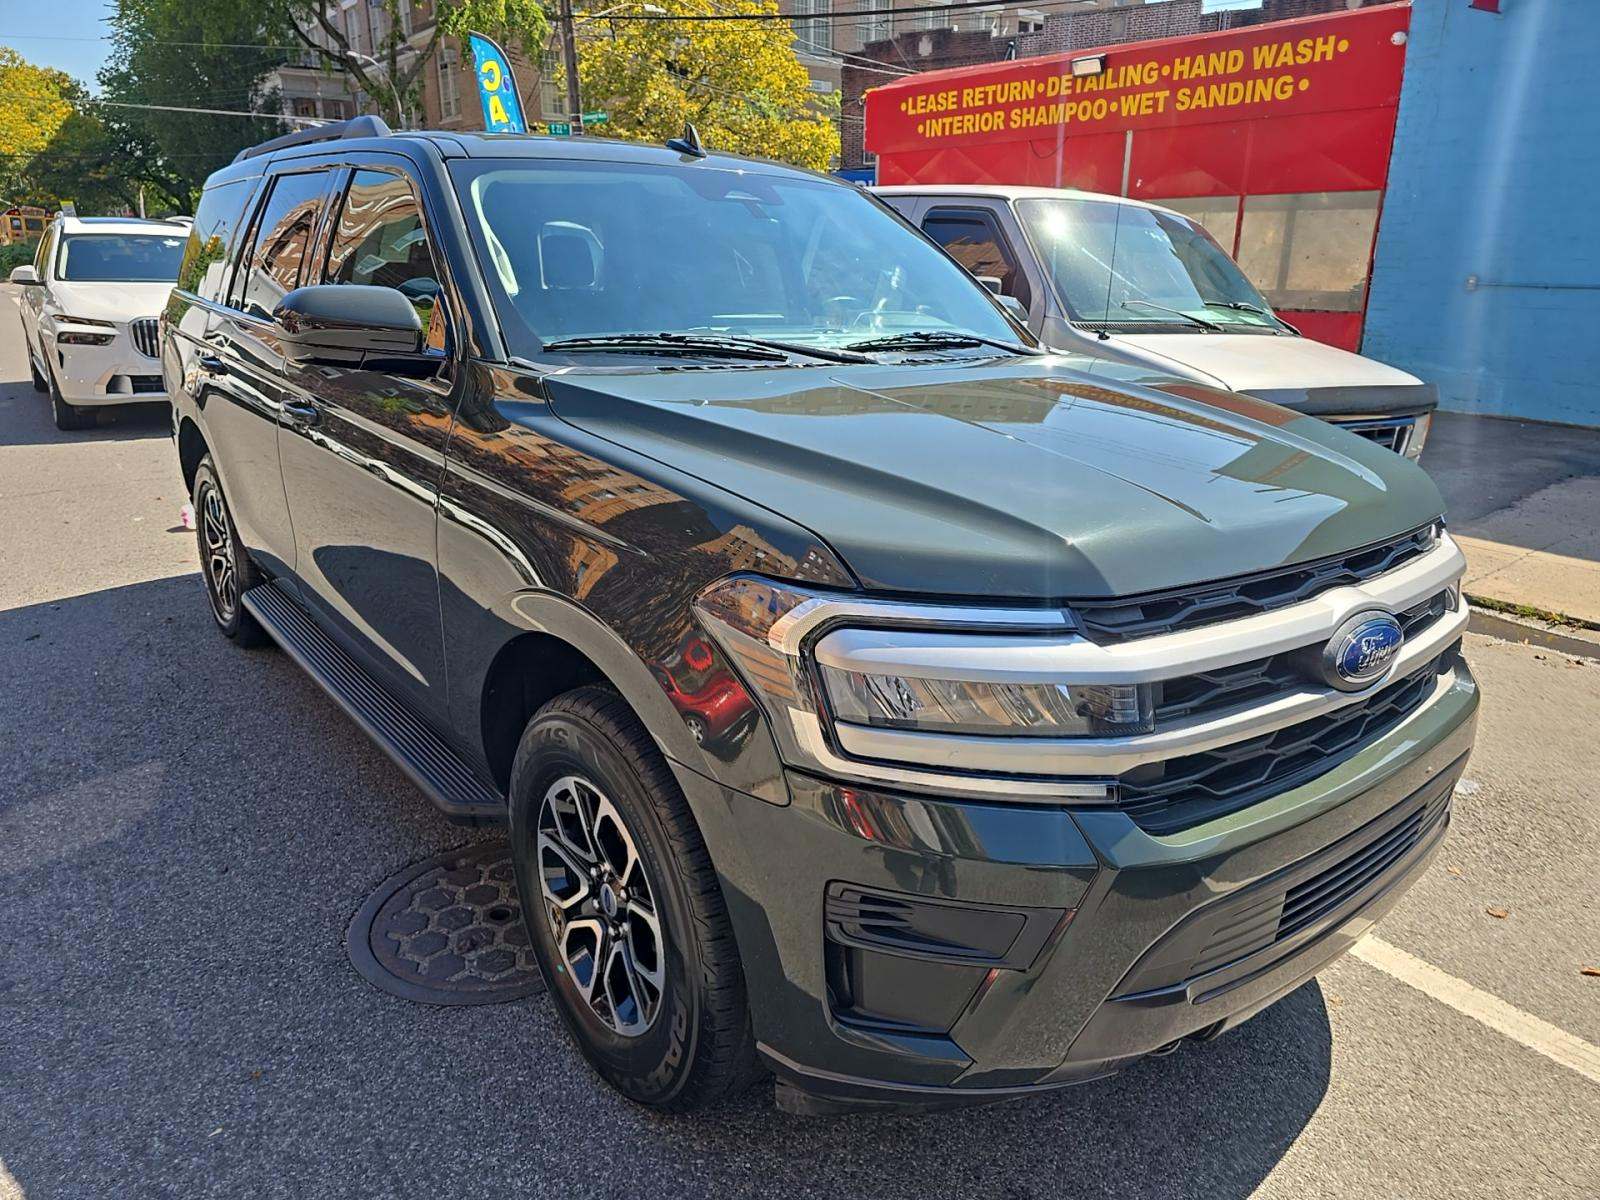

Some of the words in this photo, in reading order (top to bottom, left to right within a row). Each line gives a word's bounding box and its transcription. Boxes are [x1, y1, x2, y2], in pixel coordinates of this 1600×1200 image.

[908, 91, 957, 115] LEASE
[962, 79, 1035, 108] RETURN
[1047, 61, 1159, 97] DETAILING
[1173, 49, 1244, 80] HAND
[1253, 35, 1336, 70] WASH
[925, 111, 1005, 138] INTERIOR
[1010, 98, 1107, 129] SHAMPOO
[1121, 90, 1170, 116] WET
[1175, 75, 1294, 111] SANDING
[1358, 632, 1393, 672] Ford
